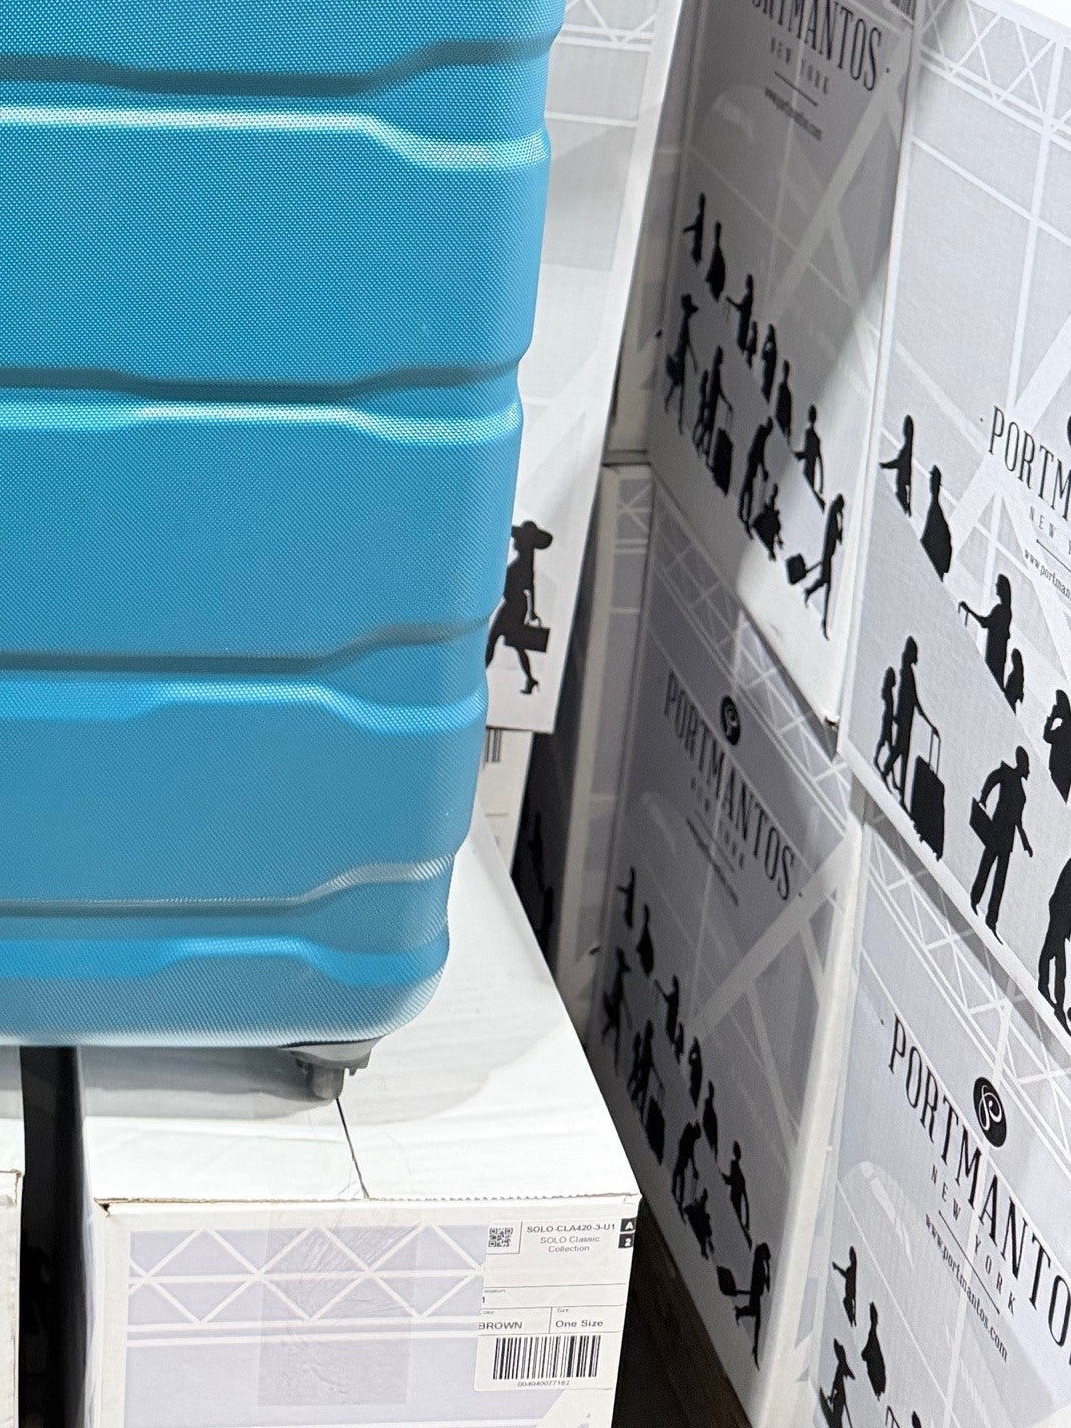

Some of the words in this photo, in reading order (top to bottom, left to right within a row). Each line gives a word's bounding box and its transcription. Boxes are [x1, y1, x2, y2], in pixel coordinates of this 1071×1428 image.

[665, 671, 795, 901] PORTMANTOS
[540, 1236, 567, 1244] SOLO
[548, 1245, 590, 1253] Collection
[888, 1013, 1071, 1365] PORTMANTO
[930, 1164, 961, 1221] NEW
[974, 1234, 1016, 1315] YORK
[555, 1320, 577, 1328] One
[581, 1319, 603, 1328] Size
[925, 1212, 1009, 1363] www.portmantos.com
